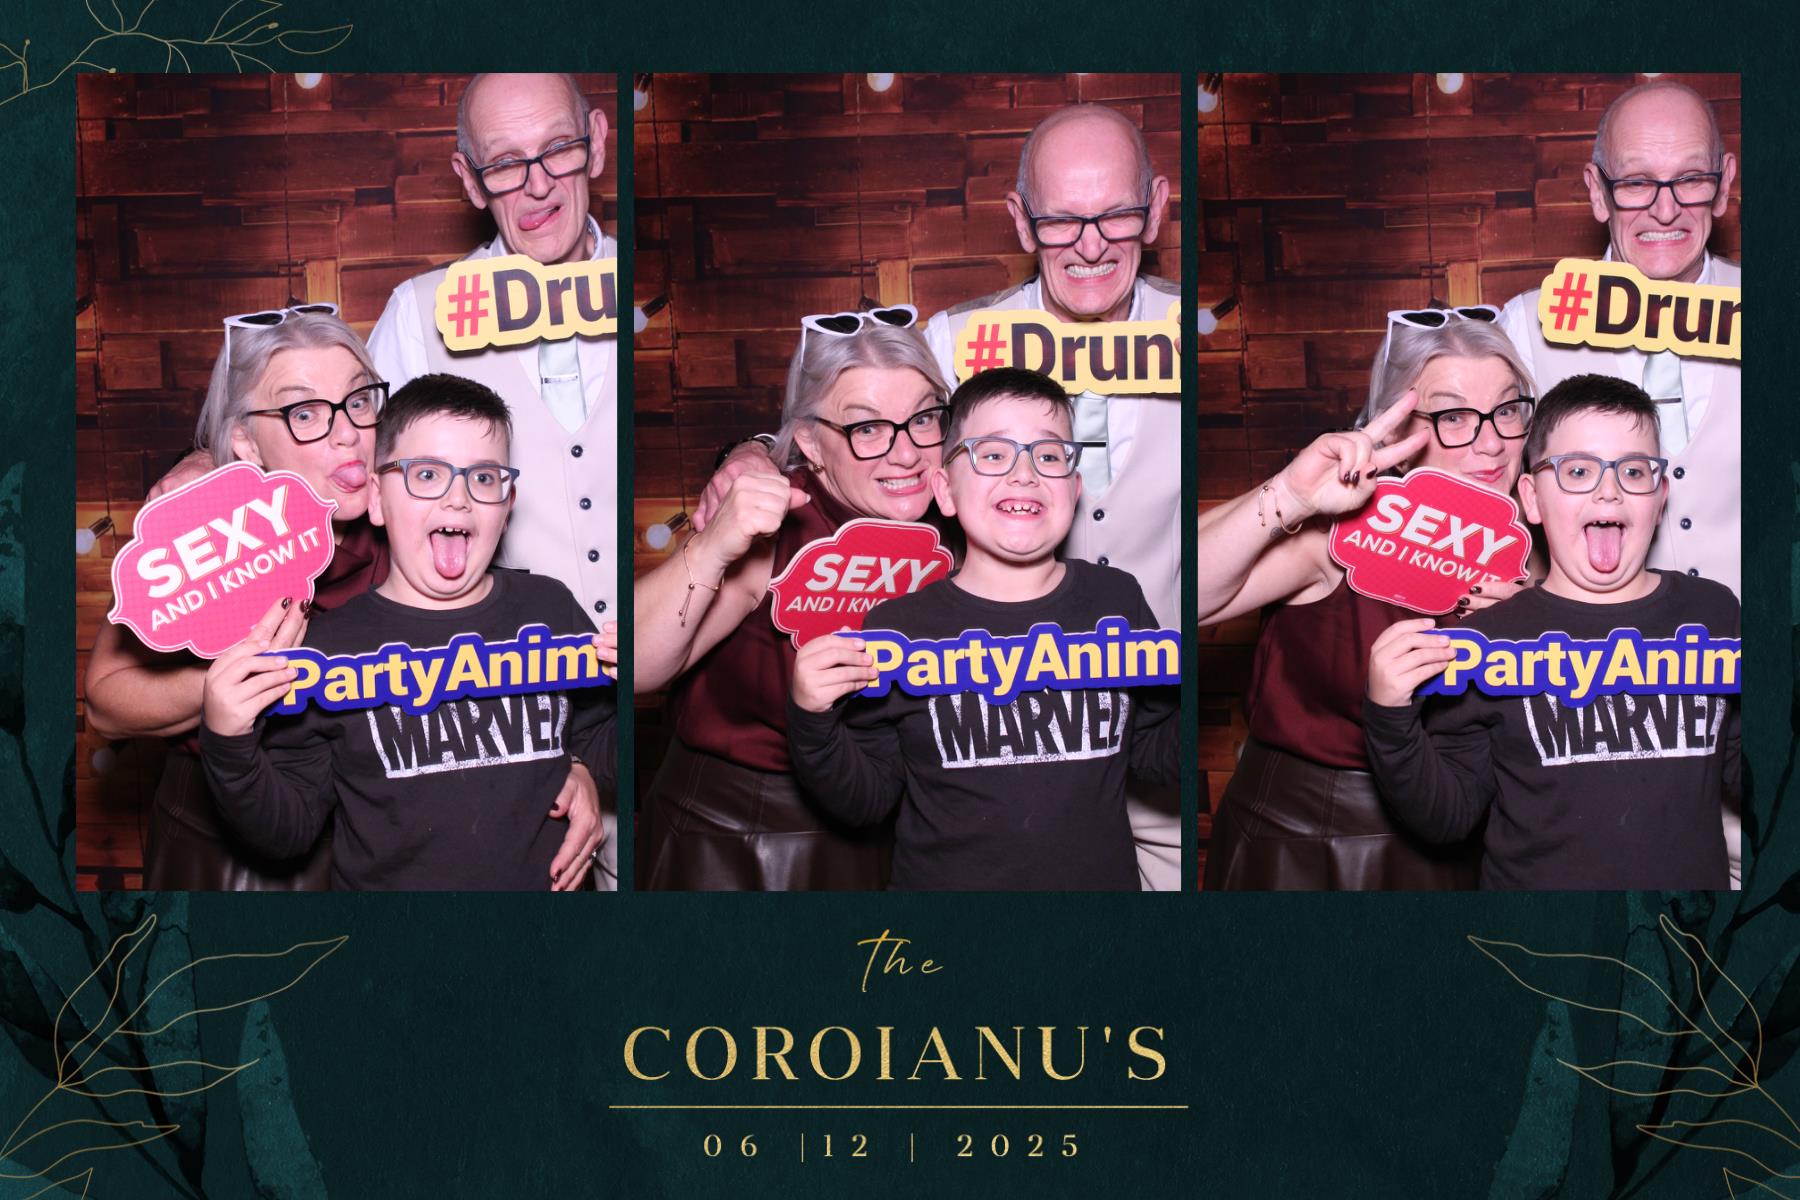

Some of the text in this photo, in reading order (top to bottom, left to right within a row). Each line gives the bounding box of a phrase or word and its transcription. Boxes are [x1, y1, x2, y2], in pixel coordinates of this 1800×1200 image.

[448, 268, 617, 337] #Dru
[137, 484, 289, 598] SEXY
[1343, 530, 1396, 556] AND
[1397, 546, 1409, 561] I
[1409, 550, 1479, 583] KNOW
[1367, 494, 1518, 565] SEXY
[151, 527, 319, 631] AND I KNOW IT
[785, 596, 888, 613] AND I KN
[805, 553, 941, 594] SEXY
[283, 635, 610, 707] PartyAnim
[366, 691, 568, 778] MARVEL
[928, 690, 1129, 768] MARVEL
[1523, 694, 1726, 767] MARVEL
